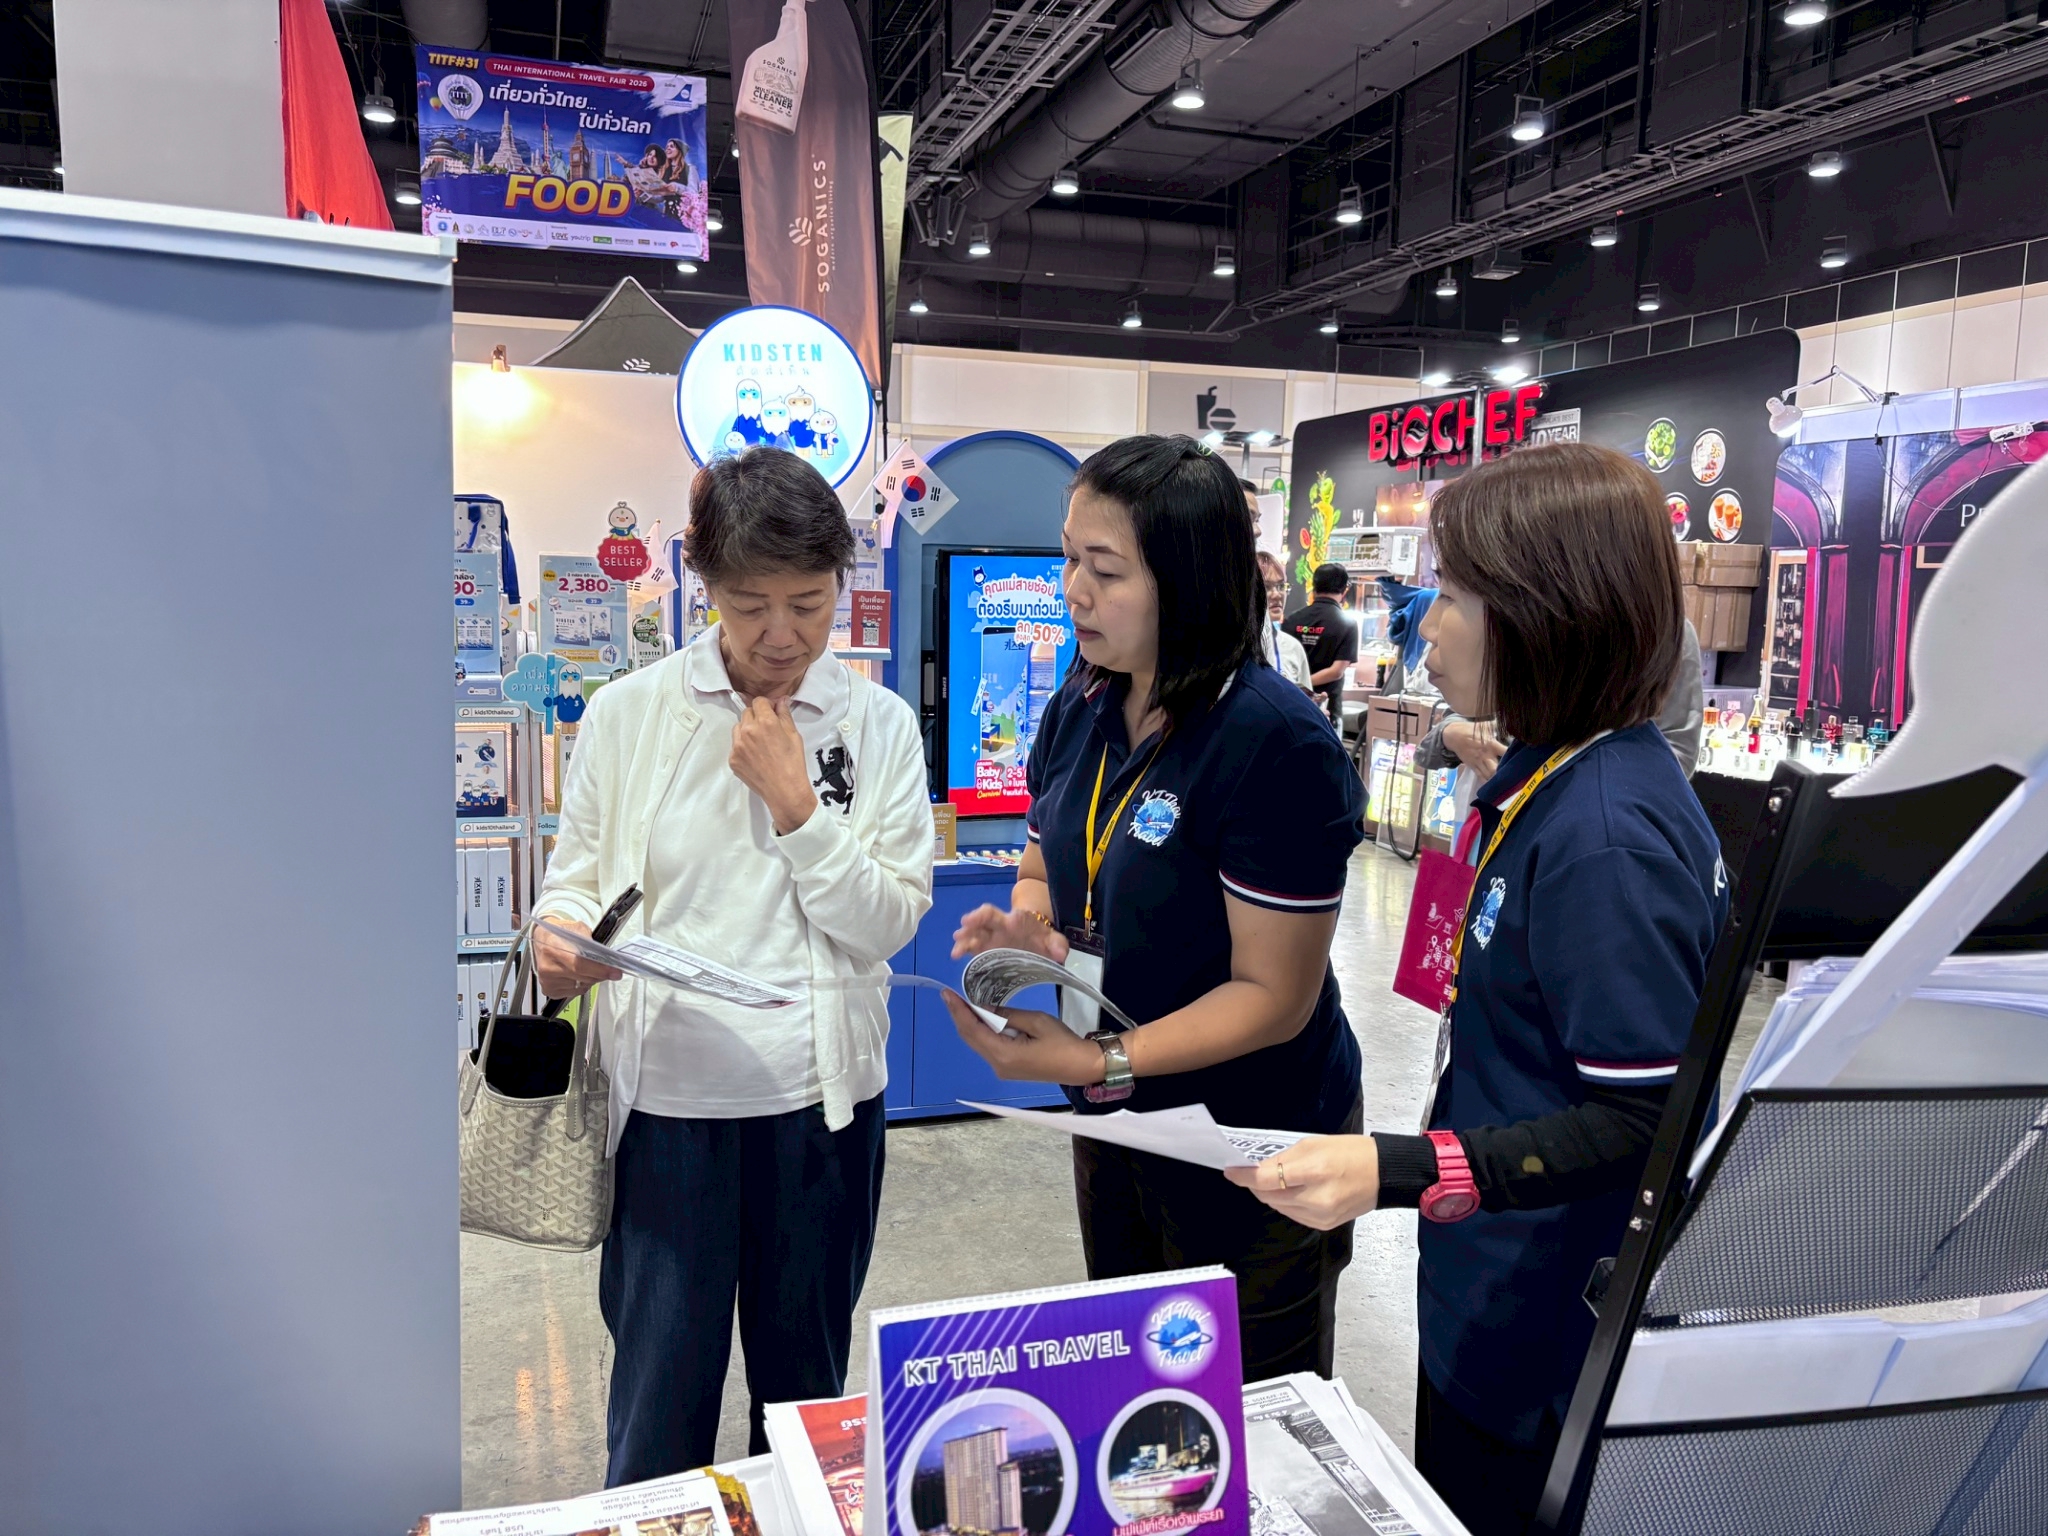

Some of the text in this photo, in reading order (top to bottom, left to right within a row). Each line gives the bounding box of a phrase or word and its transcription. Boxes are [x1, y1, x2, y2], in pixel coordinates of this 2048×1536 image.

[428, 53, 479, 69] TITF#31
[493, 63, 648, 87] THAI INTERNATIONAL TRAVEL FAIR 2026
[753, 90, 792, 110] CLEANER
[579, 109, 651, 135] ไปทั่วโลก
[505, 173, 631, 217] FOOD
[813, 160, 830, 293] SOGANICS
[724, 344, 822, 361] KIDSTEN
[1548, 425, 1577, 442] YEAR
[610, 545, 636, 555] BEST
[603, 556, 643, 567] SELLER
[558, 578, 616, 593] 2,380.-
[984, 576, 1056, 598] คุณแม่สายช้อป
[978, 597, 1062, 617] ต้องรีบมาด่วน!
[1017, 621, 1064, 643] ลด 50%
[976, 766, 1001, 779] Baby
[982, 778, 1003, 790] Kids
[1151, 1301, 1176, 1327] KT
[904, 1330, 1130, 1388] KT THAI TRAVEL
[1157, 1344, 1206, 1368] Travel
